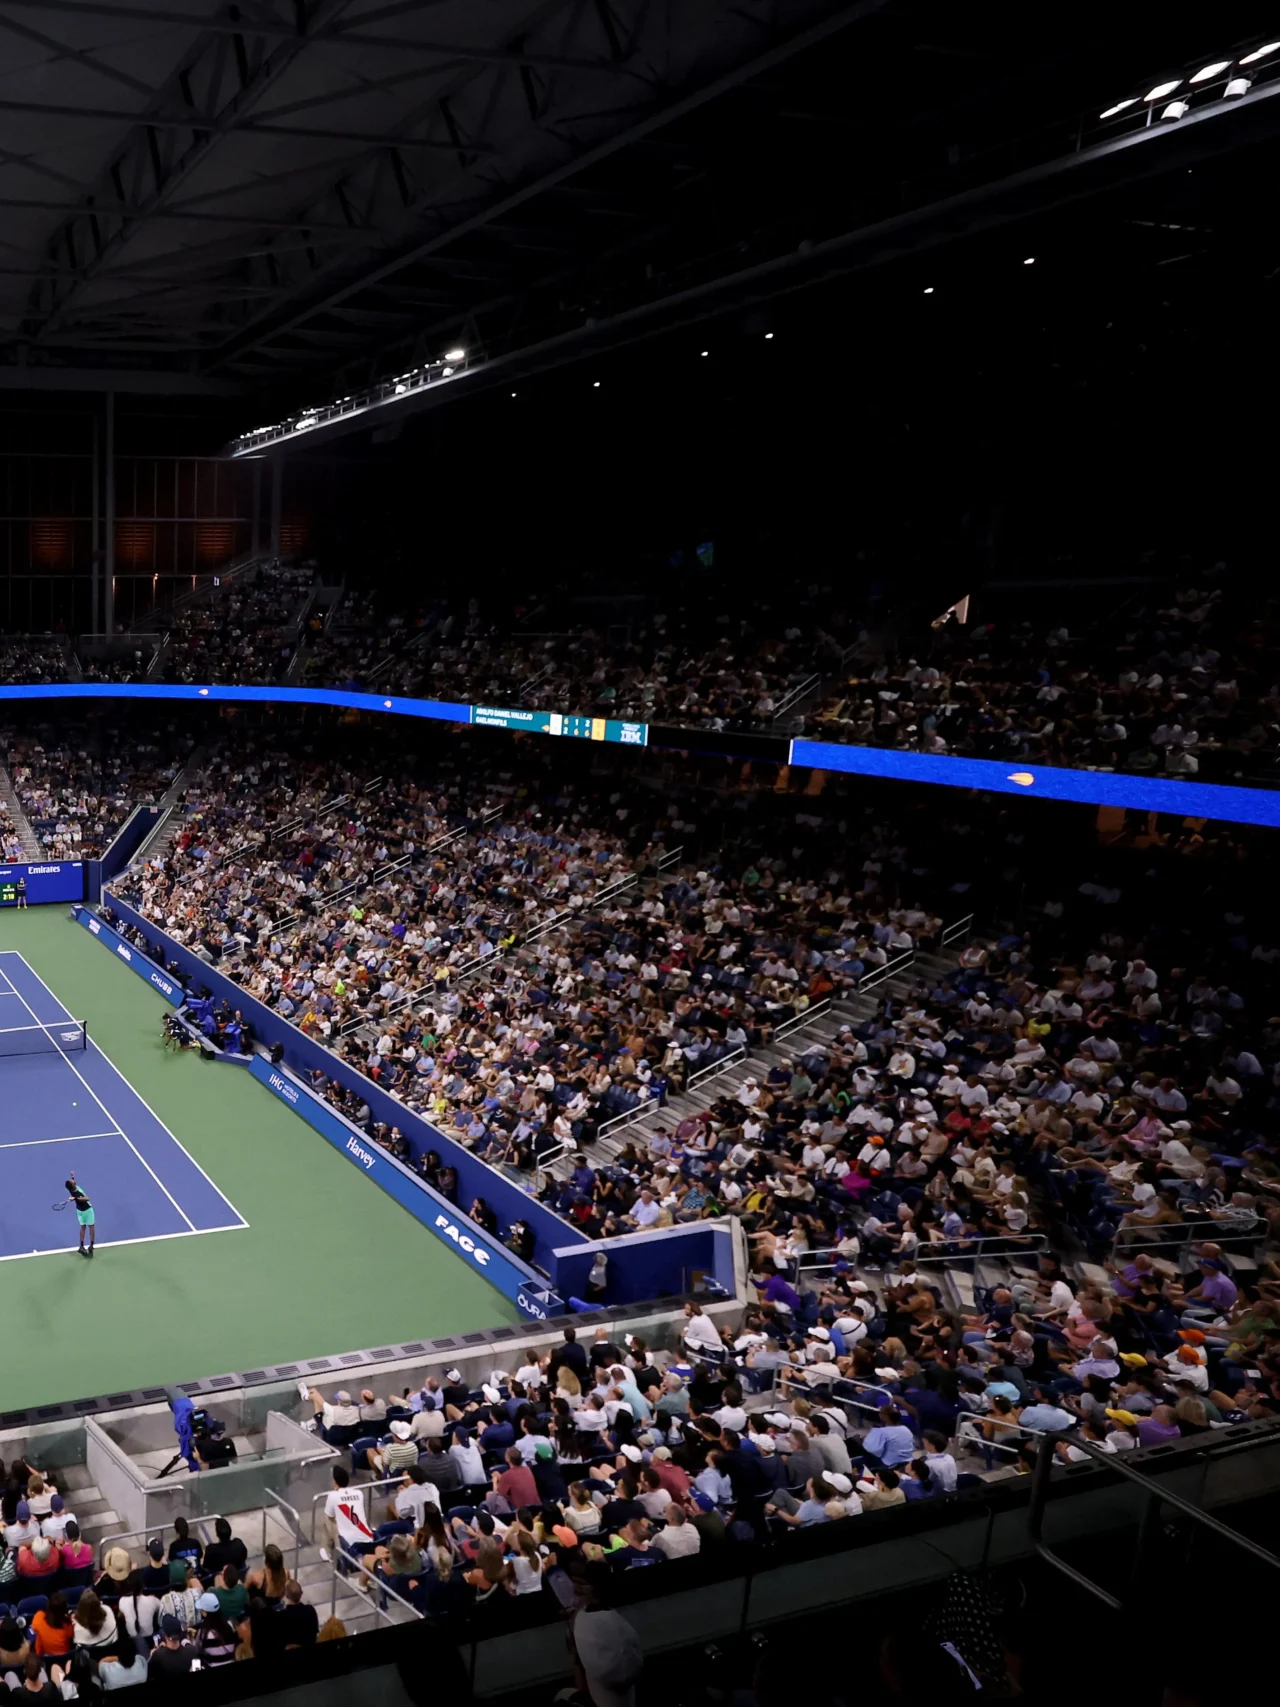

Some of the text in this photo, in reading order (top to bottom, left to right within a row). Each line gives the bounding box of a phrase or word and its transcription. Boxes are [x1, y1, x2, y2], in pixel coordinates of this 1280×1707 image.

[621, 730, 642, 744] IBM
[27, 865, 61, 875] Emirates
[150, 973, 173, 995] CHUBB
[268, 1073, 285, 1091] IHG
[346, 1136, 376, 1169] Harvey
[435, 1214, 491, 1266] FAGE
[350, 1504, 359, 1526] 6
